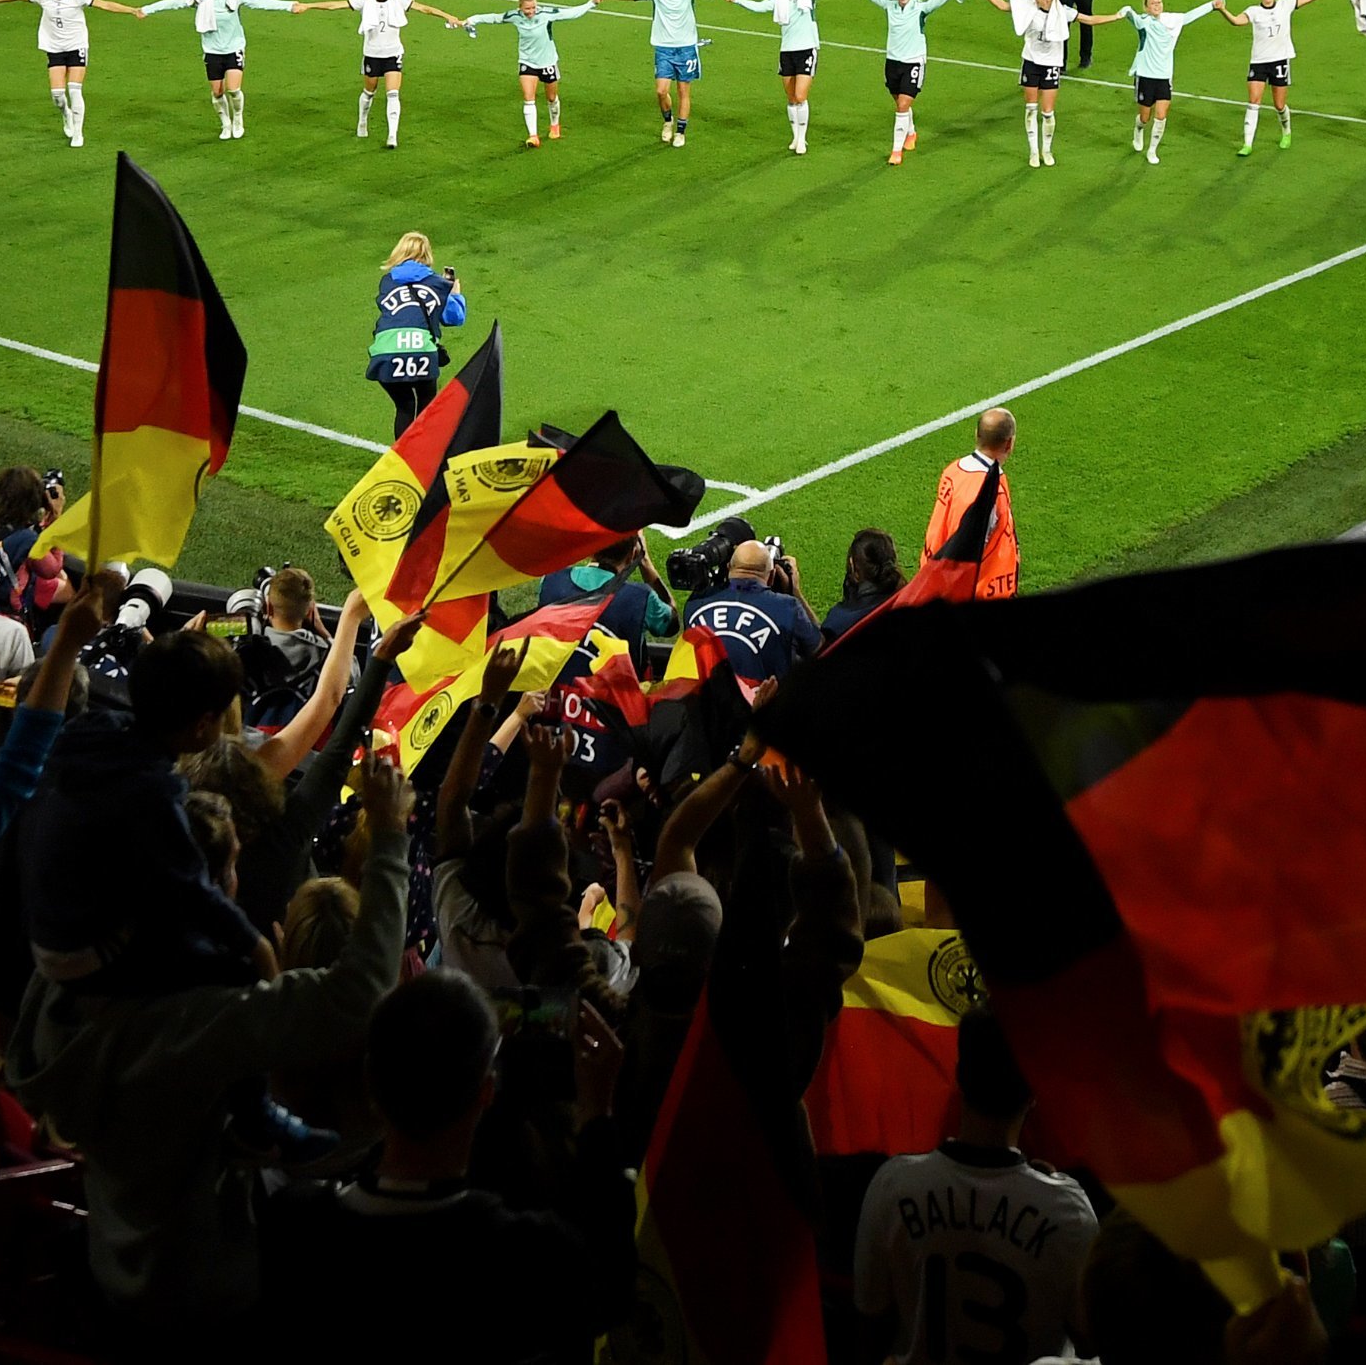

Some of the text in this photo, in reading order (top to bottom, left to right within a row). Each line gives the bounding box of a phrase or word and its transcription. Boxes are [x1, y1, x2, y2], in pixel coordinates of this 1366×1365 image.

[396, 331, 435, 349] HB
[391, 356, 440, 378] 262
[340, 527, 361, 558] CLUB
[898, 1186, 1059, 1259] BALLACK
[925, 1250, 1030, 1365] 13
